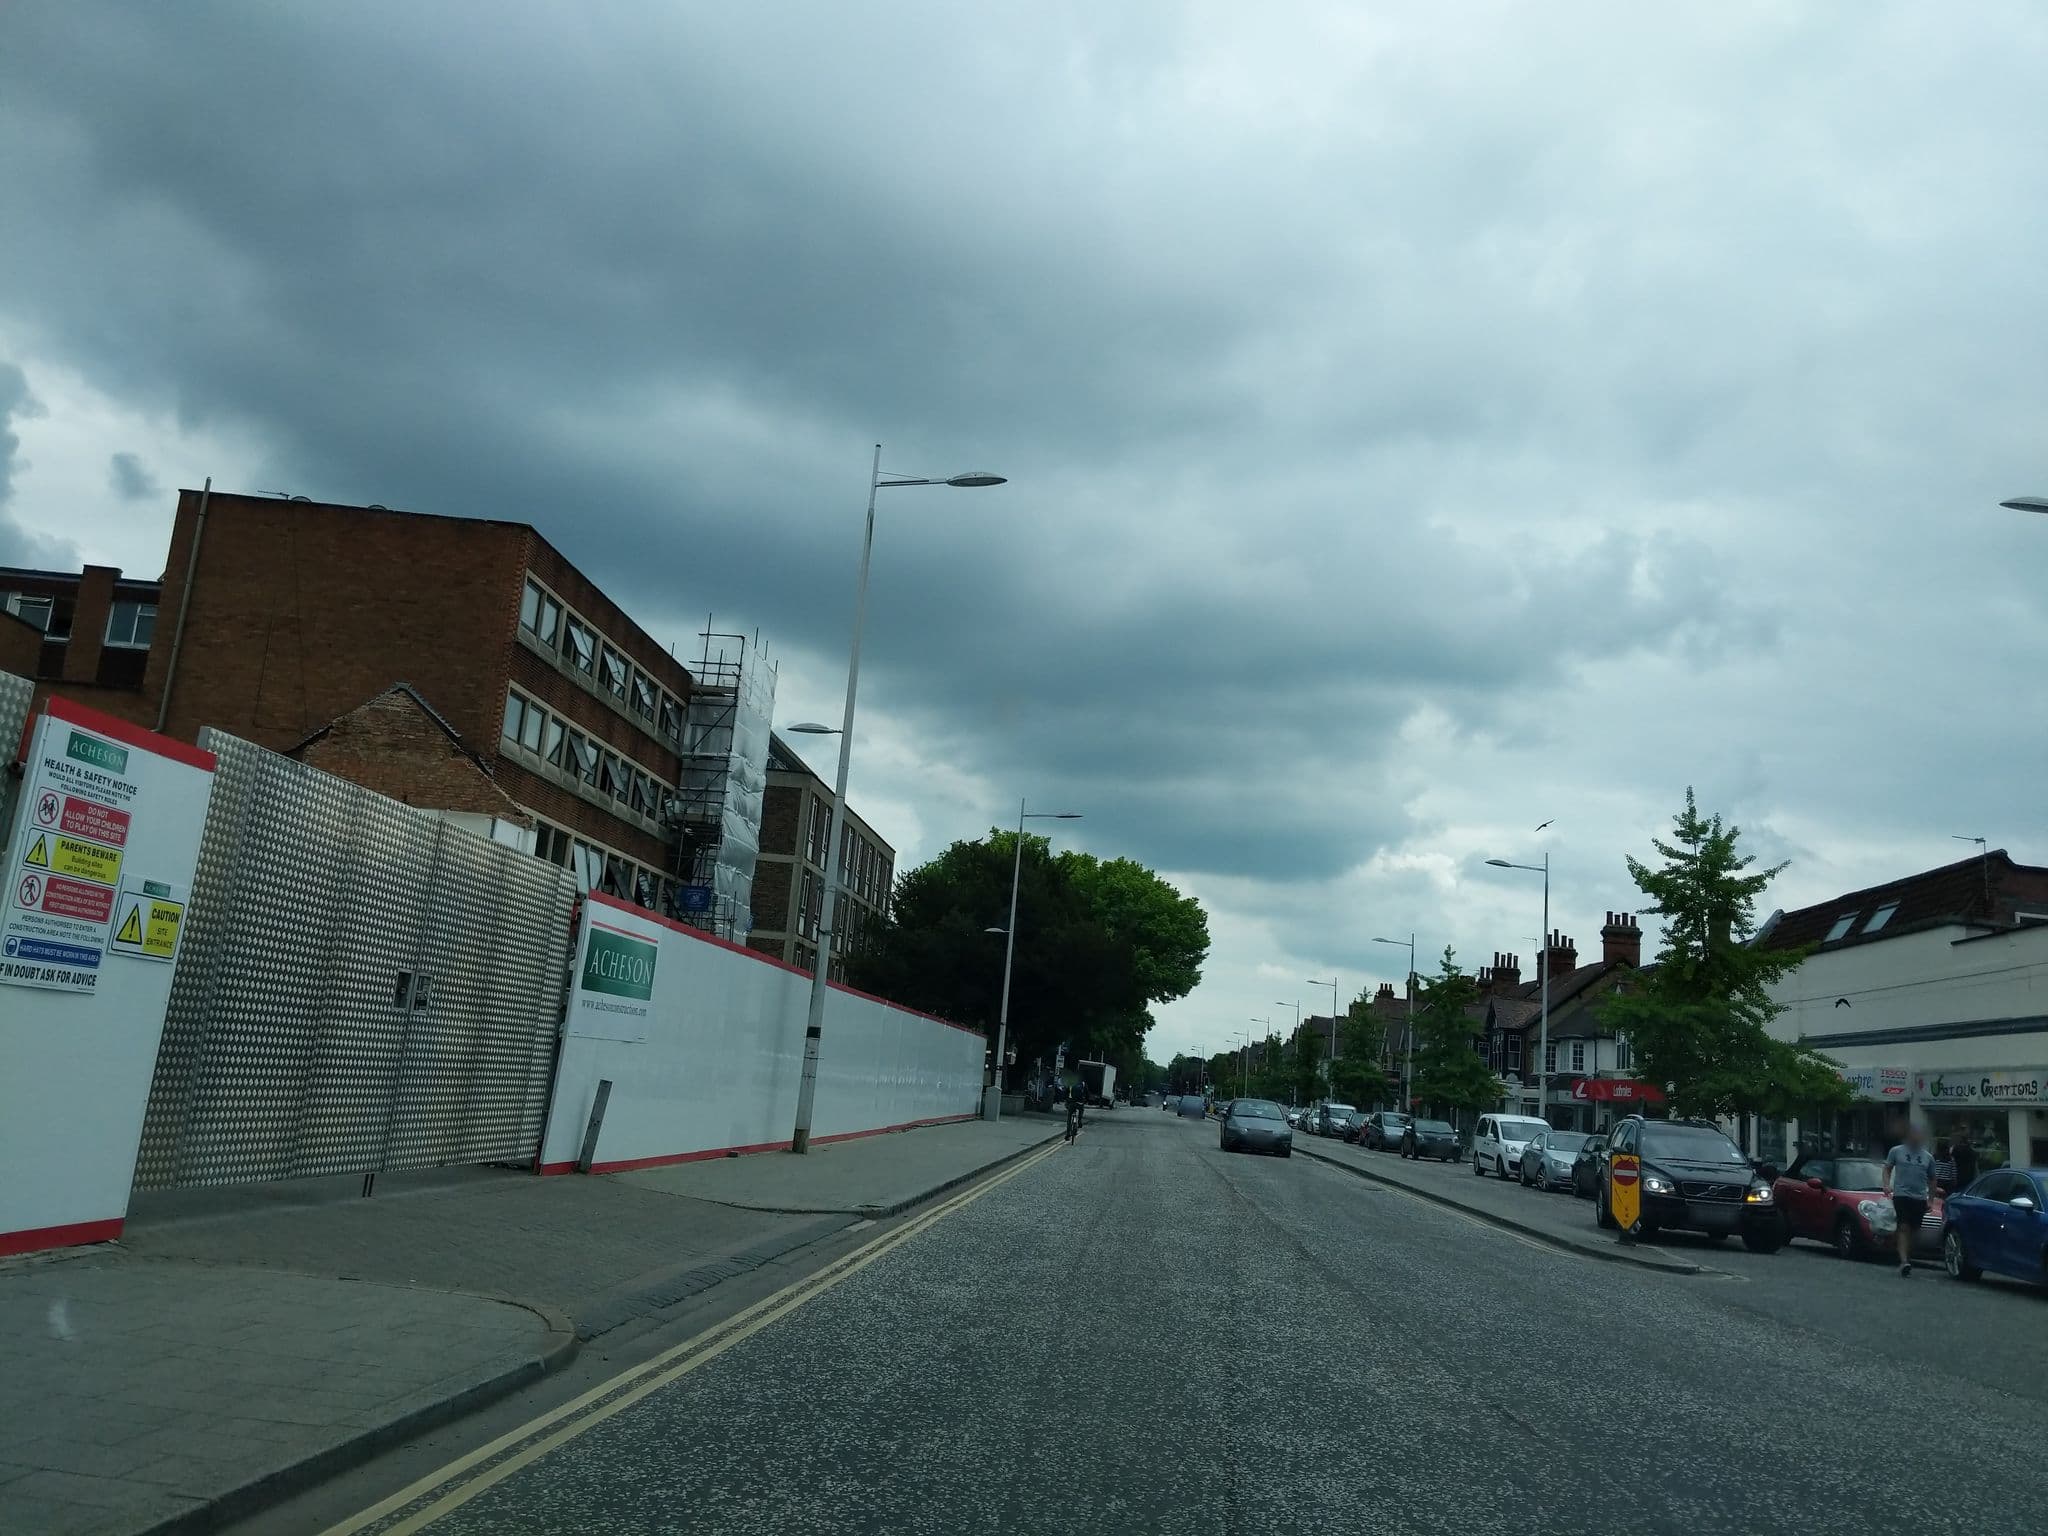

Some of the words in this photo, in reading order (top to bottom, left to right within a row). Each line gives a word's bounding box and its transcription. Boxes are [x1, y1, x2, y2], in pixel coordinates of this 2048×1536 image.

[72, 740, 124, 768] ACHESON
[44, 758, 75, 776] HEALTH
[76, 768, 82, 777] &
[84, 770, 112, 786] SAFETY
[112, 780, 138, 796] NOTICE
[48, 771, 65, 781] WOULD
[66, 776, 74, 784] ALL
[75, 778, 95, 790] VISITORS
[95, 785, 111, 795] PLEASE
[112, 790, 122, 798] NOTE
[60, 784, 87, 796] FOLLOWING
[87, 791, 104, 801] SAFETY
[105, 796, 118, 805] RULES
[65, 810, 85, 820] ALLOW
[86, 816, 101, 825] YOUR
[101, 819, 126, 833] CHILDREN
[88, 806, 96, 815] DO
[97, 809, 108, 818] NOT
[66, 820, 75, 829] TO
[75, 822, 89, 832] PLAY
[89, 826, 97, 834] ON
[97, 829, 110, 838] THIS
[110, 832, 121, 841] SITE
[60, 840, 91, 856] PARENTS
[92, 848, 118, 862] BEWARE
[72, 855, 91, 867] Building
[91, 860, 103, 869] sites
[80, 867, 106, 878] dangerous
[21, 914, 44, 924] PERSONS
[45, 919, 72, 929] AUTHORISED
[152, 908, 180, 924] CAUTION
[9, 923, 46, 934] CONSTRUCTION
[60, 931, 71, 939] NOTE
[80, 935, 104, 944] FOLLOWING
[157, 928, 168, 936] SITE
[20, 945, 33, 953] HARD
[45, 948, 56, 956] MUST
[88, 953, 99, 962] AREA
[146, 938, 174, 949] ENTRANCE
[4, 964, 14, 977] IN
[14, 965, 41, 980] DOUBT
[40, 968, 55, 982] ASK
[56, 970, 72, 984] FOR
[72, 972, 97, 986] ADVICE
[589, 947, 653, 984] ACHESON
